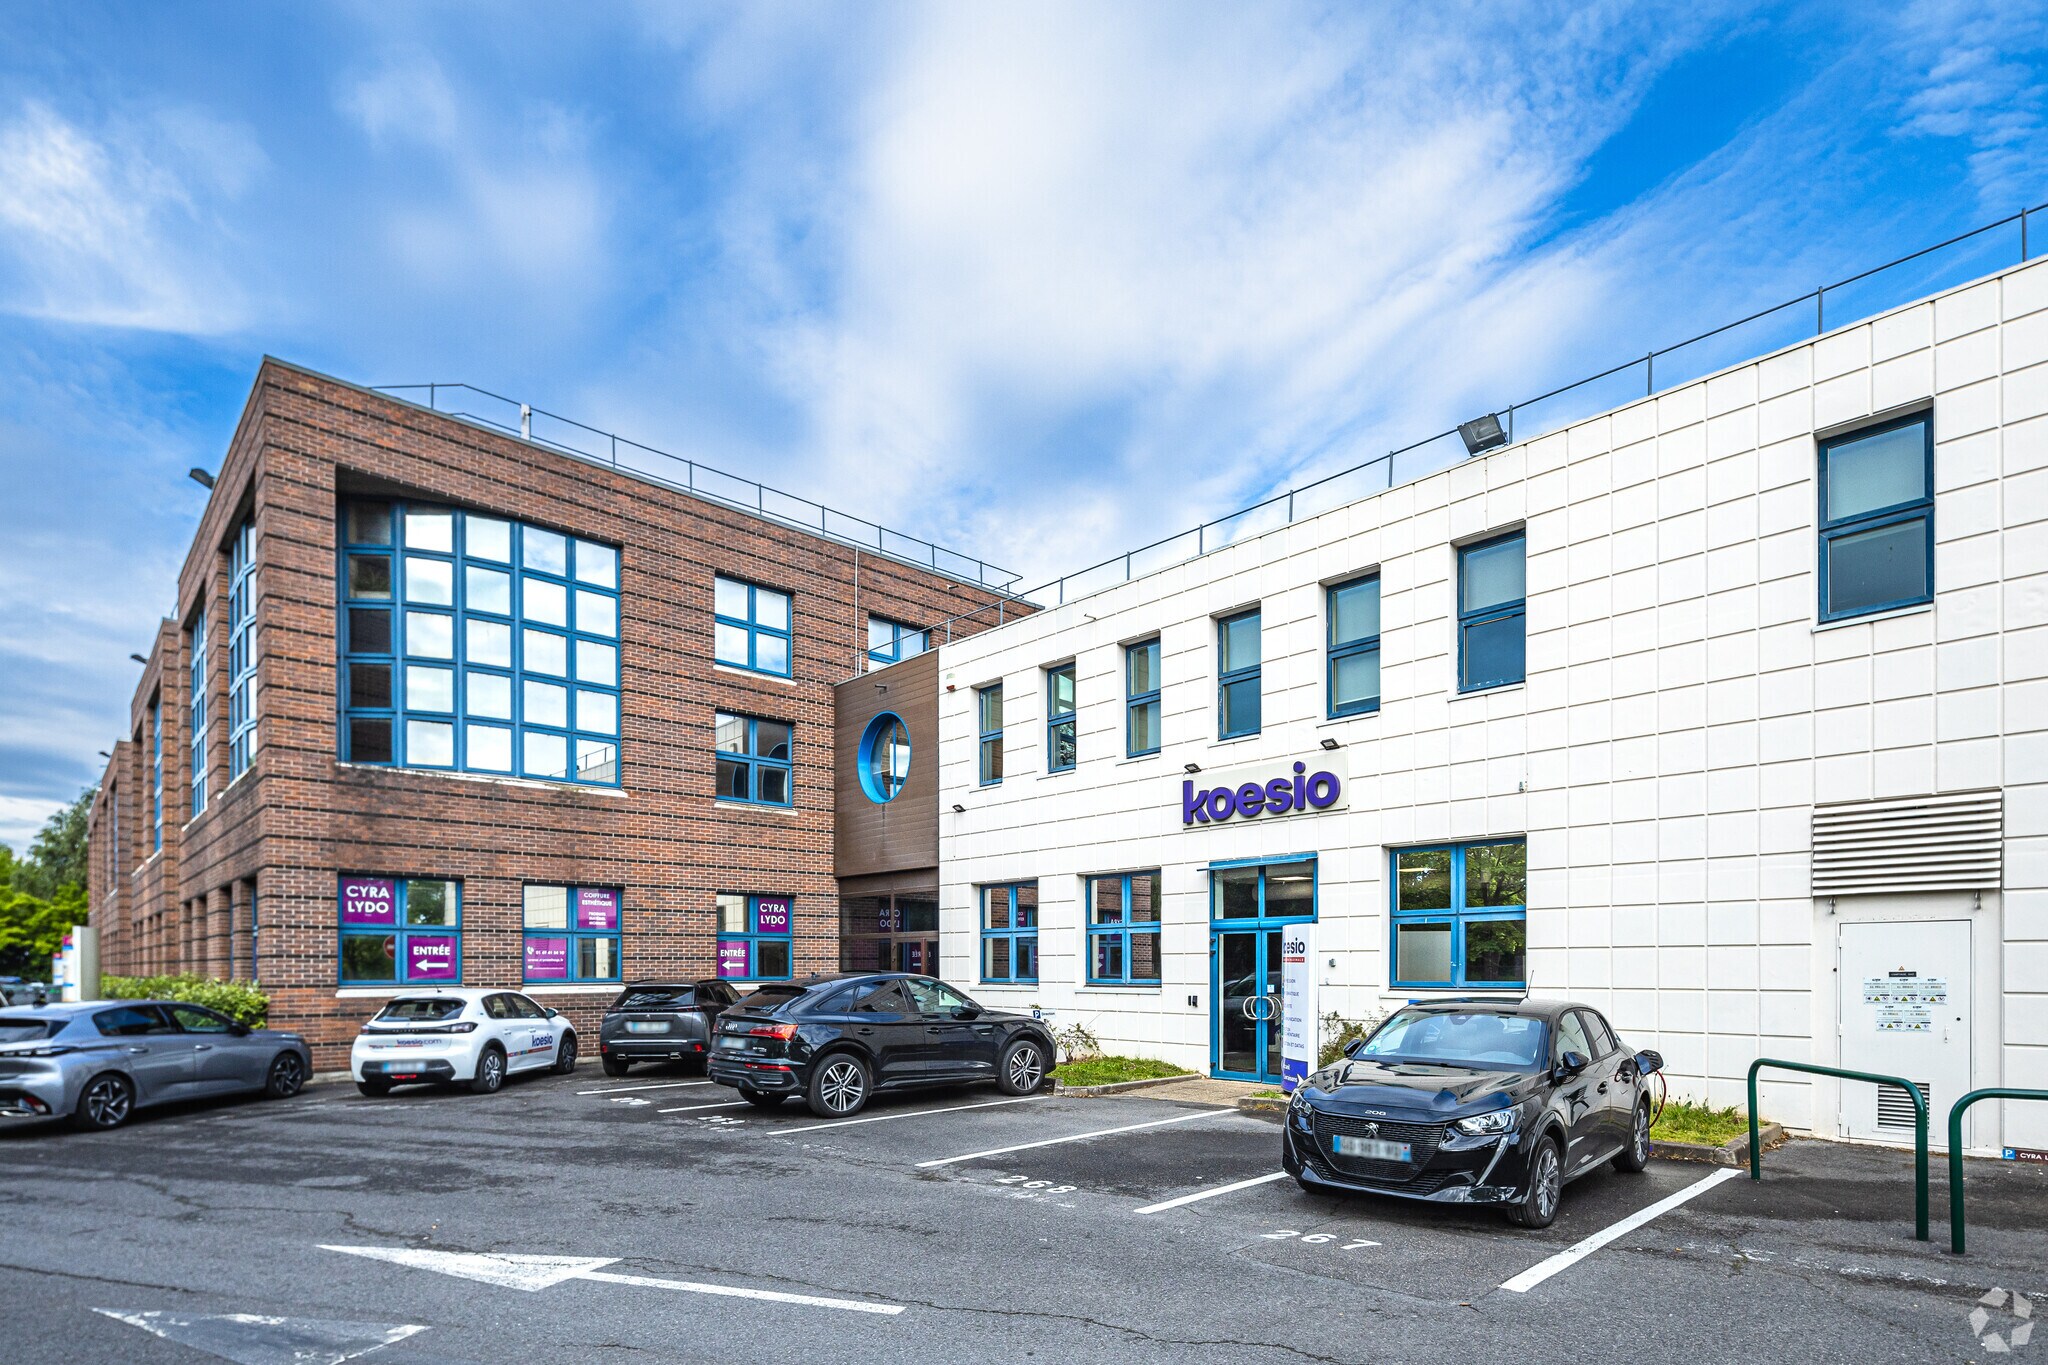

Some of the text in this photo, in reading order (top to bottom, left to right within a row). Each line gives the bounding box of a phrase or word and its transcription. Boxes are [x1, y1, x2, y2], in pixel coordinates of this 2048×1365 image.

[1182, 760, 1341, 826] koesio
[346, 885, 390, 899] CYRA
[347, 901, 389, 914] LYDO
[760, 903, 786, 913] CYRA
[760, 915, 786, 925] LYDO
[413, 944, 451, 956] ENTRÉE
[720, 948, 746, 957] ENTRÉE
[396, 1038, 442, 1046] koesio.com
[531, 1033, 553, 1047] koesio
[2005, 1149, 2013, 1157] P
[2020, 1152, 2042, 1160] CYRA
[995, 1175, 1078, 1193] 268
[1259, 1229, 1383, 1250] 267
